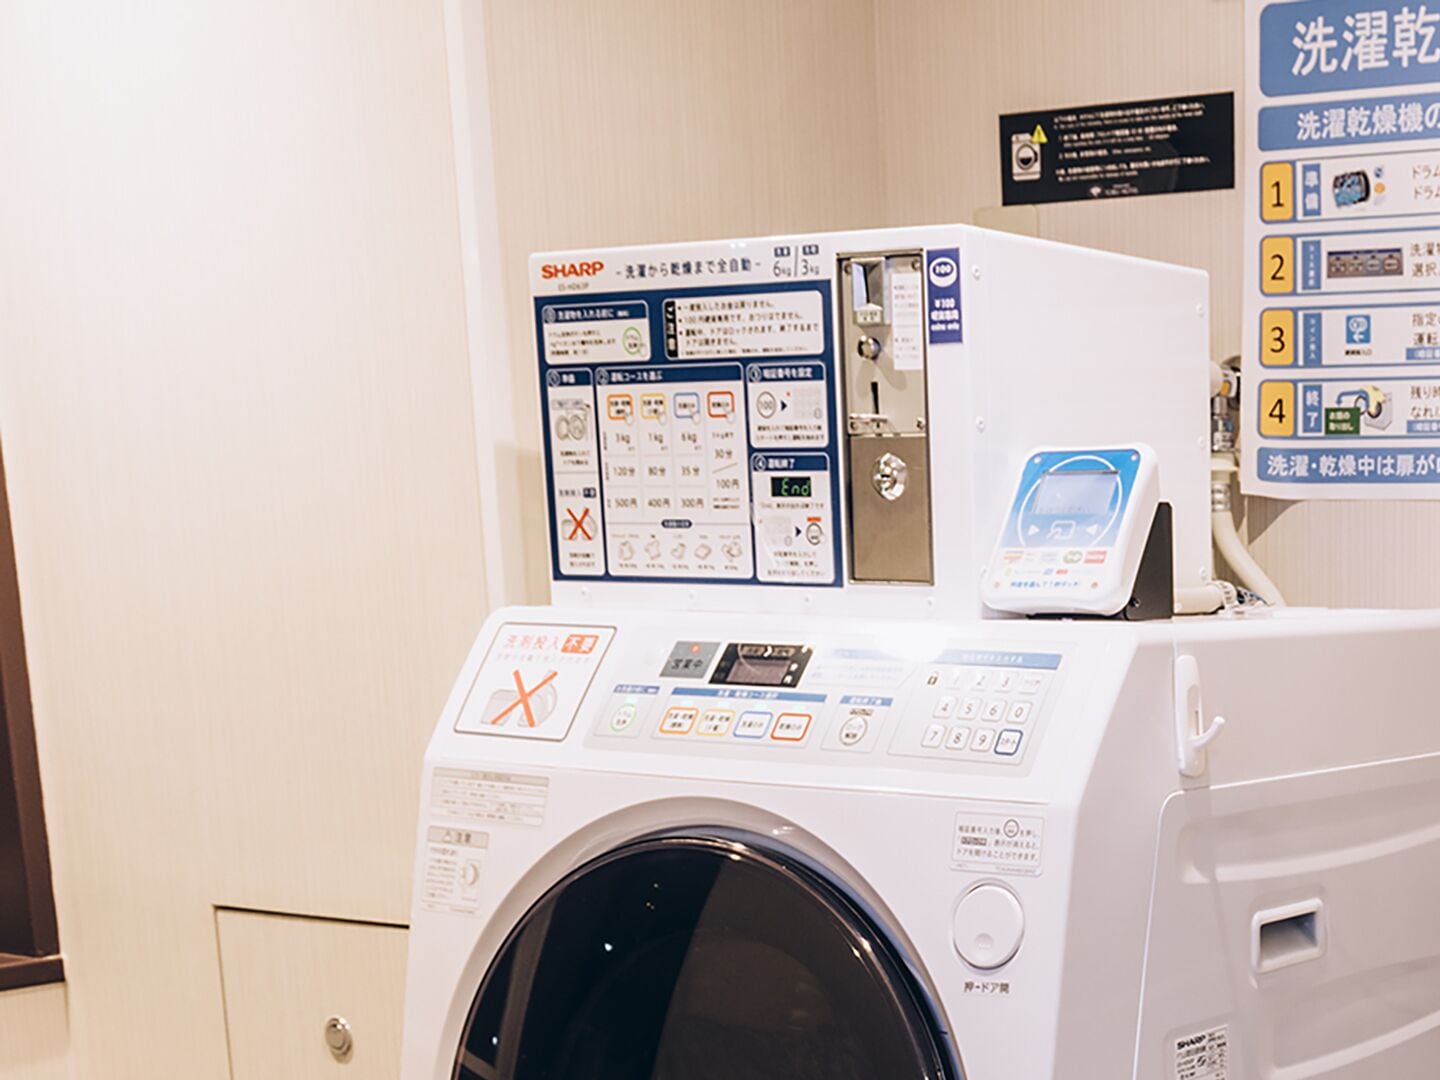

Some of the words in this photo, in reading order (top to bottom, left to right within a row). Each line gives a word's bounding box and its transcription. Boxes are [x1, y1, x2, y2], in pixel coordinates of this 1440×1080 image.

[1271, 181, 1285, 208] 1
[540, 260, 605, 280] SHARP
[1270, 254, 1285, 281] 2
[1270, 326, 1286, 353] 3
[1268, 397, 1286, 425] 4
[781, 478, 811, 496] End
[1177, 1034, 1207, 1050] SHARP
